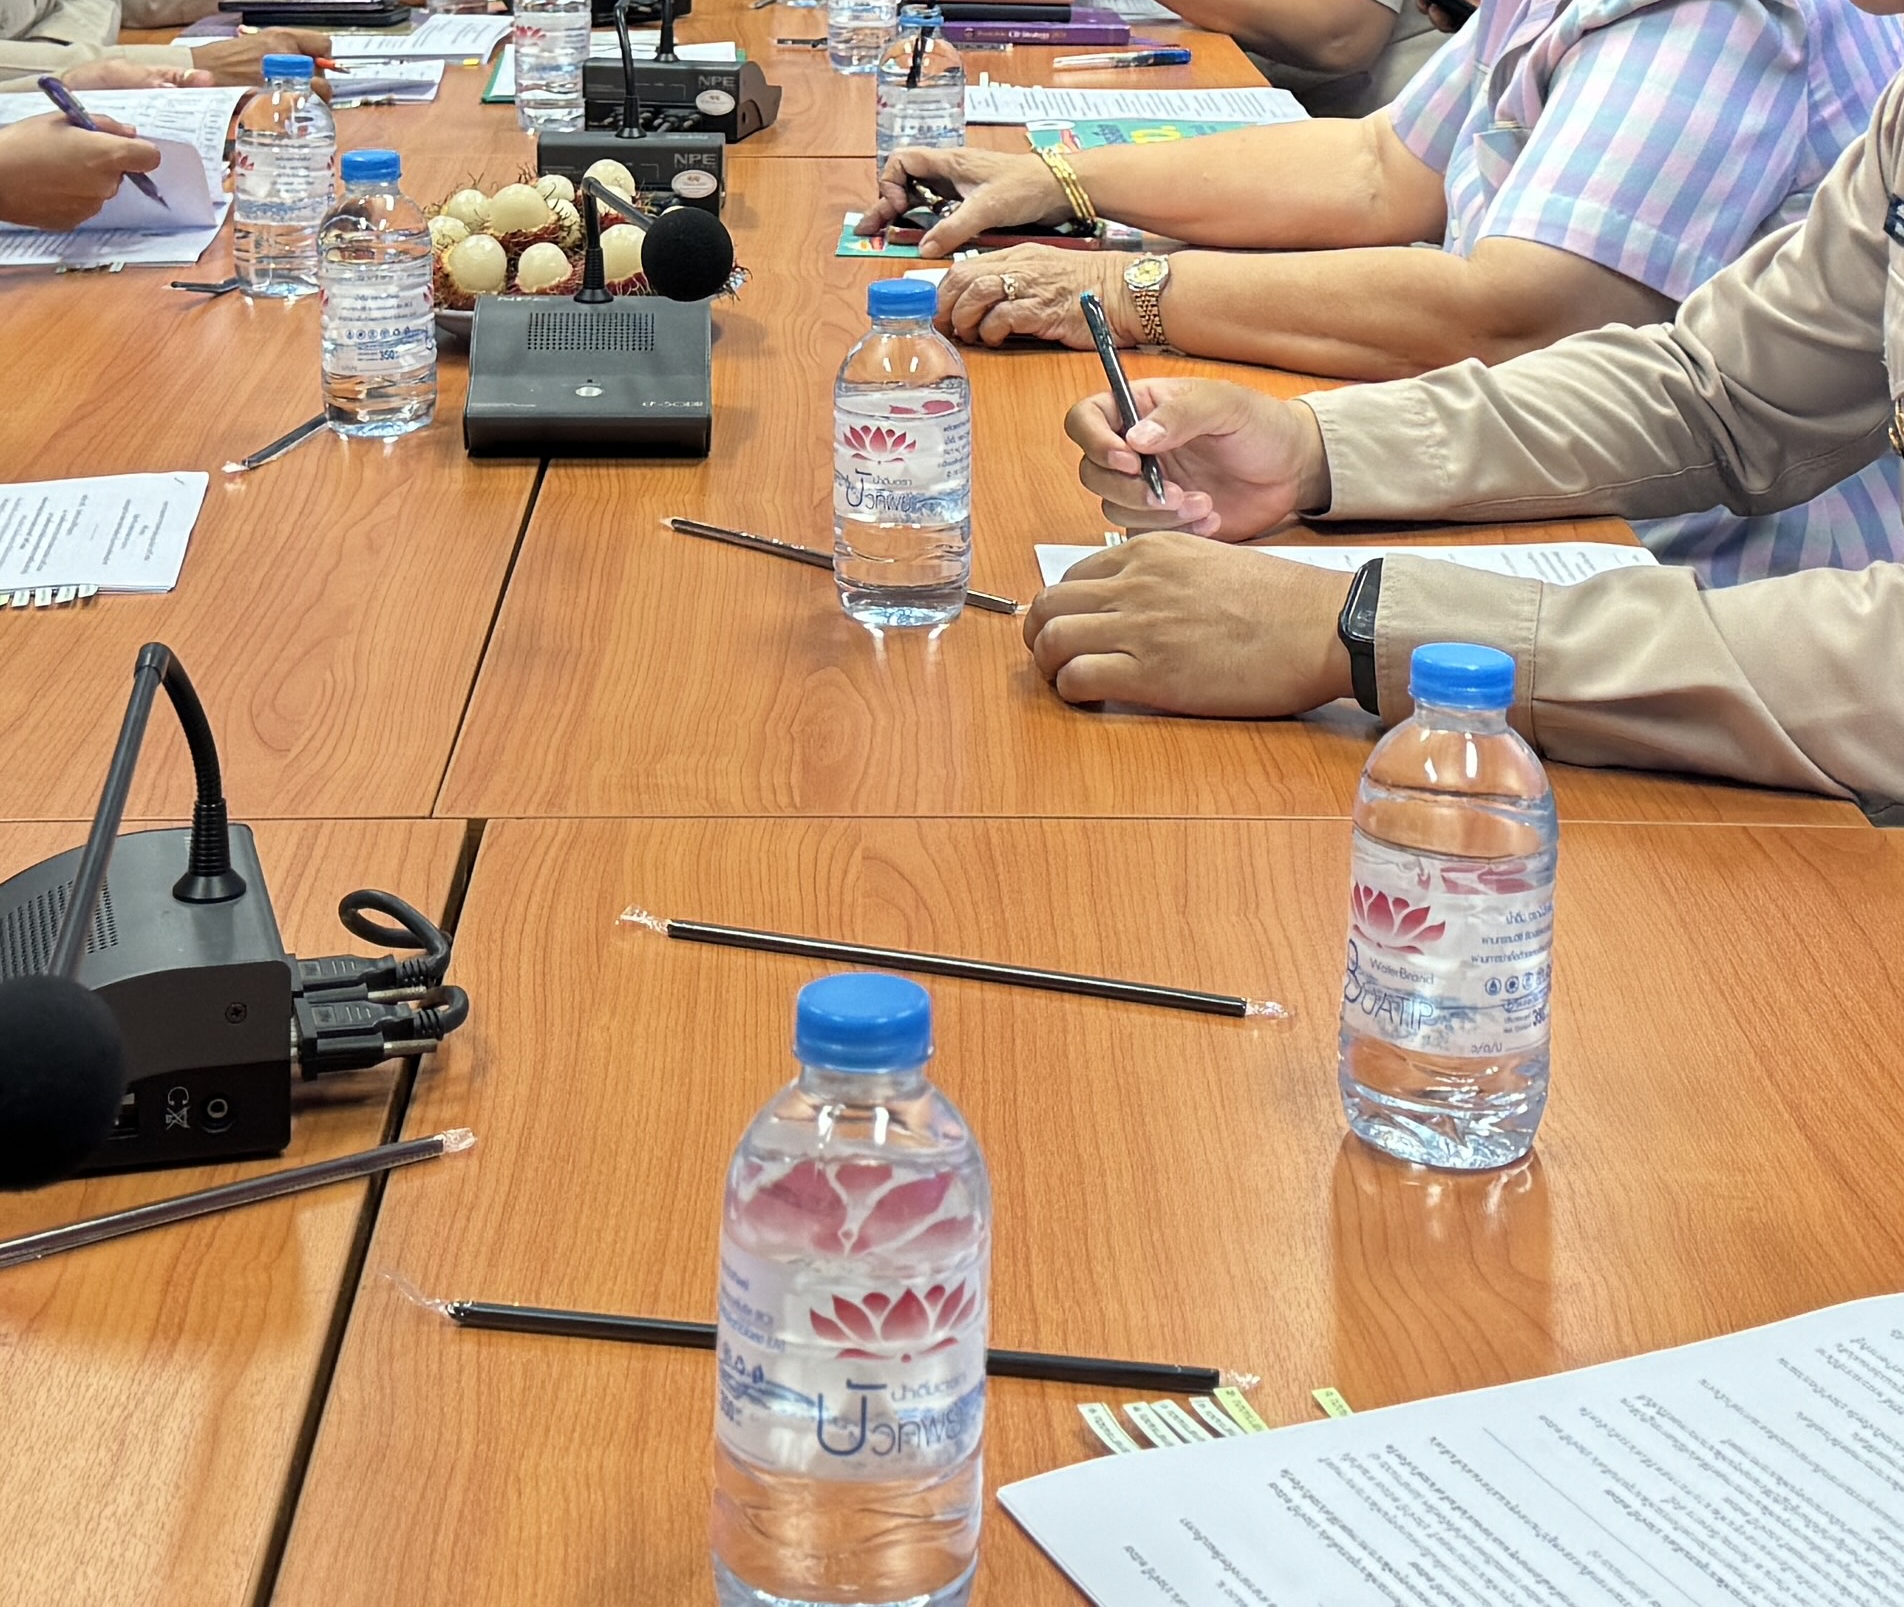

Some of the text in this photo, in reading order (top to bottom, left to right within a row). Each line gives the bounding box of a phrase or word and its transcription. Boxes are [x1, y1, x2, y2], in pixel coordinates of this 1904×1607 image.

[697, 75, 737, 87] NPE
[673, 153, 717, 165] NPE
[1369, 956, 1435, 985] Water Brand
